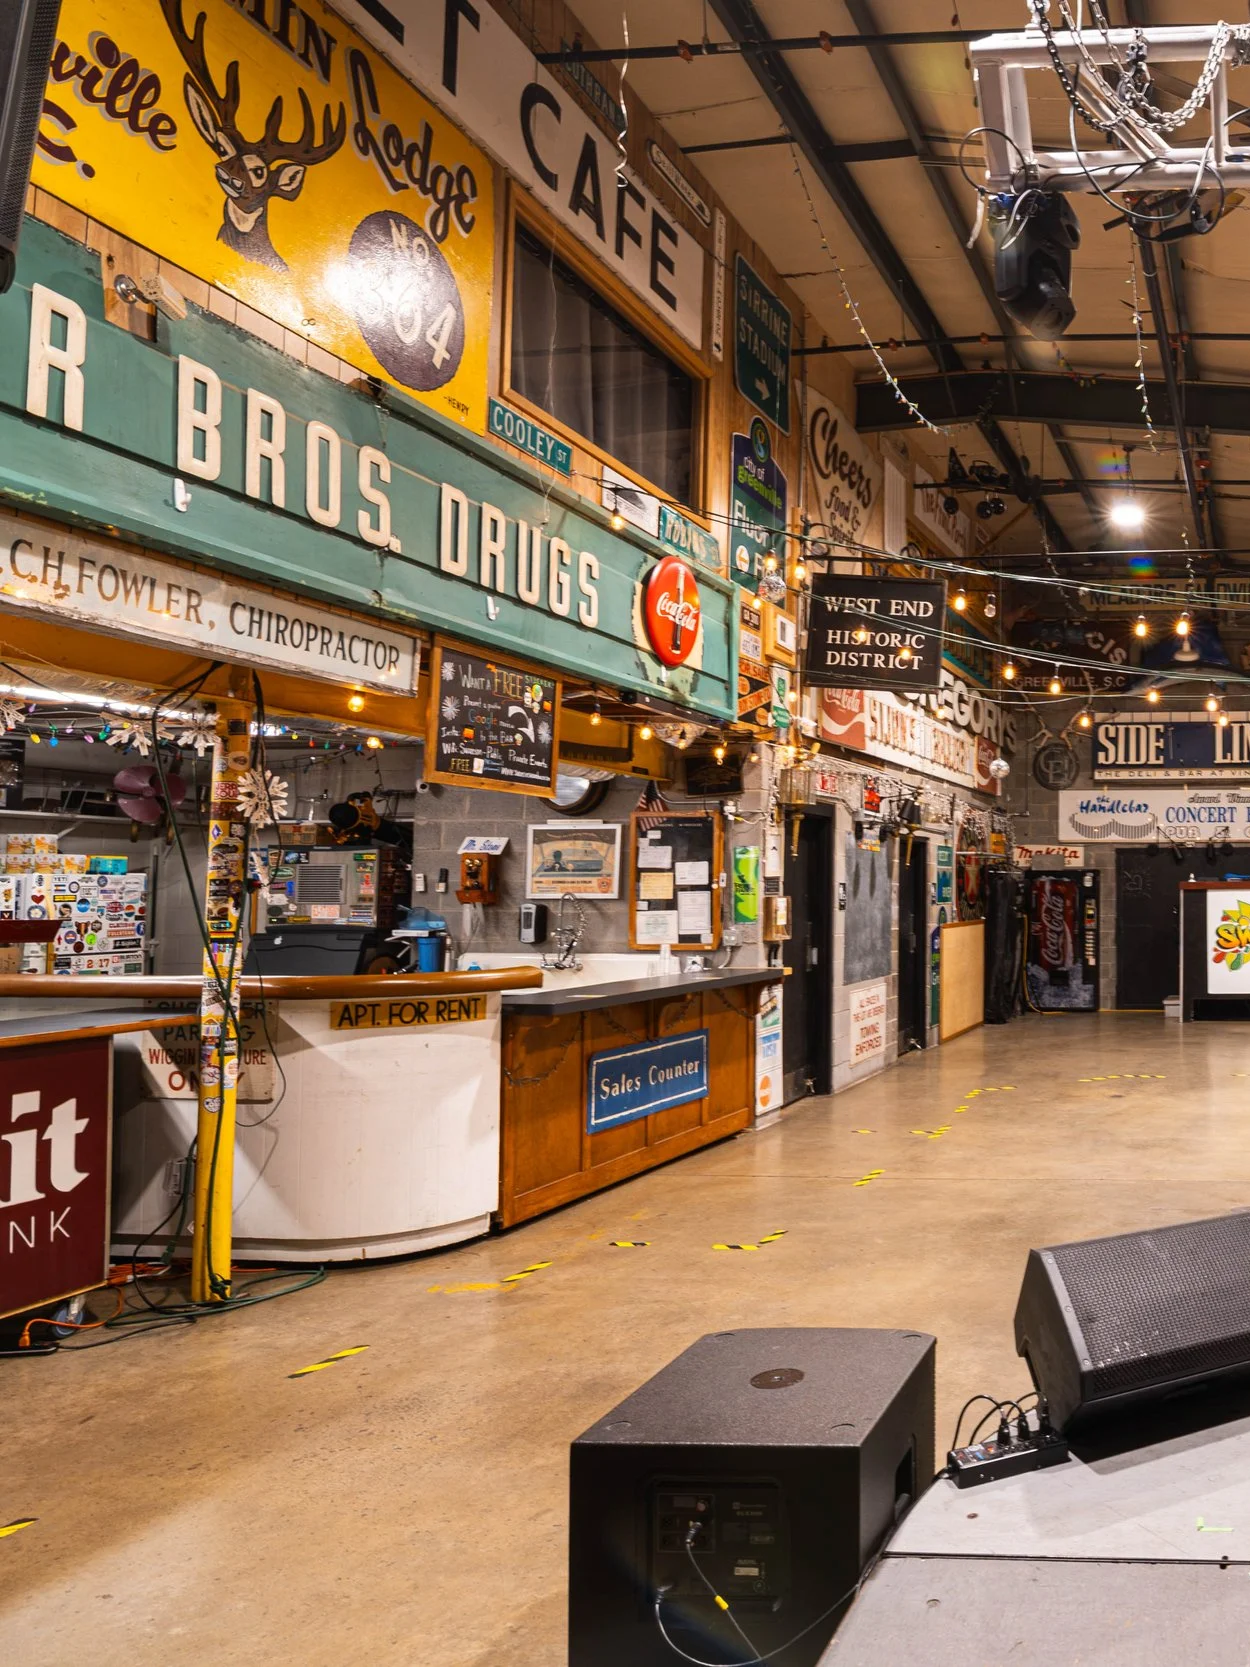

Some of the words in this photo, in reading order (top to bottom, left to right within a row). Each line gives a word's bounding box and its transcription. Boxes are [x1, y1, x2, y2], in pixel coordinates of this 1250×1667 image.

[345, 46, 479, 243] Lodge
[520, 82, 679, 312] CAFE
[738, 275, 789, 347] SIRRINE
[739, 317, 787, 386] STADIUM
[492, 403, 556, 461] COOLEY
[556, 448, 568, 465] ST
[26, 282, 87, 432] R
[176, 353, 402, 553] BROS.
[440, 482, 600, 628] DRUGS
[743, 456, 756, 478] city
[757, 466, 766, 481] of
[810, 406, 873, 511] Cheers
[737, 464, 783, 510] greenville
[735, 499, 770, 548] Fluor
[75, 556, 216, 631] FOWLER,
[228, 600, 401, 673] CHIROPRACTOR
[824, 596, 881, 615] WEST
[890, 599, 935, 618] END
[826, 629, 926, 649] HISTORIC
[825, 651, 924, 671] DISTRICT
[459, 664, 485, 690] WANT
[493, 669, 524, 698] FREE
[467, 709, 498, 729] Google
[1097, 724, 1165, 765] SIDE
[1079, 800, 1149, 814] Handlebar
[1165, 806, 1237, 824] CONCERT
[1188, 792, 1221, 804] Award
[1164, 826, 1201, 838] PUB
[1015, 845, 1081, 860] Makita
[337, 1003, 381, 1028] APT.
[388, 1001, 429, 1025] FOR
[436, 997, 481, 1022] RENT
[148, 1047, 196, 1065] WIGGIN
[600, 1073, 641, 1101] Sales
[648, 1057, 700, 1087] Counter
